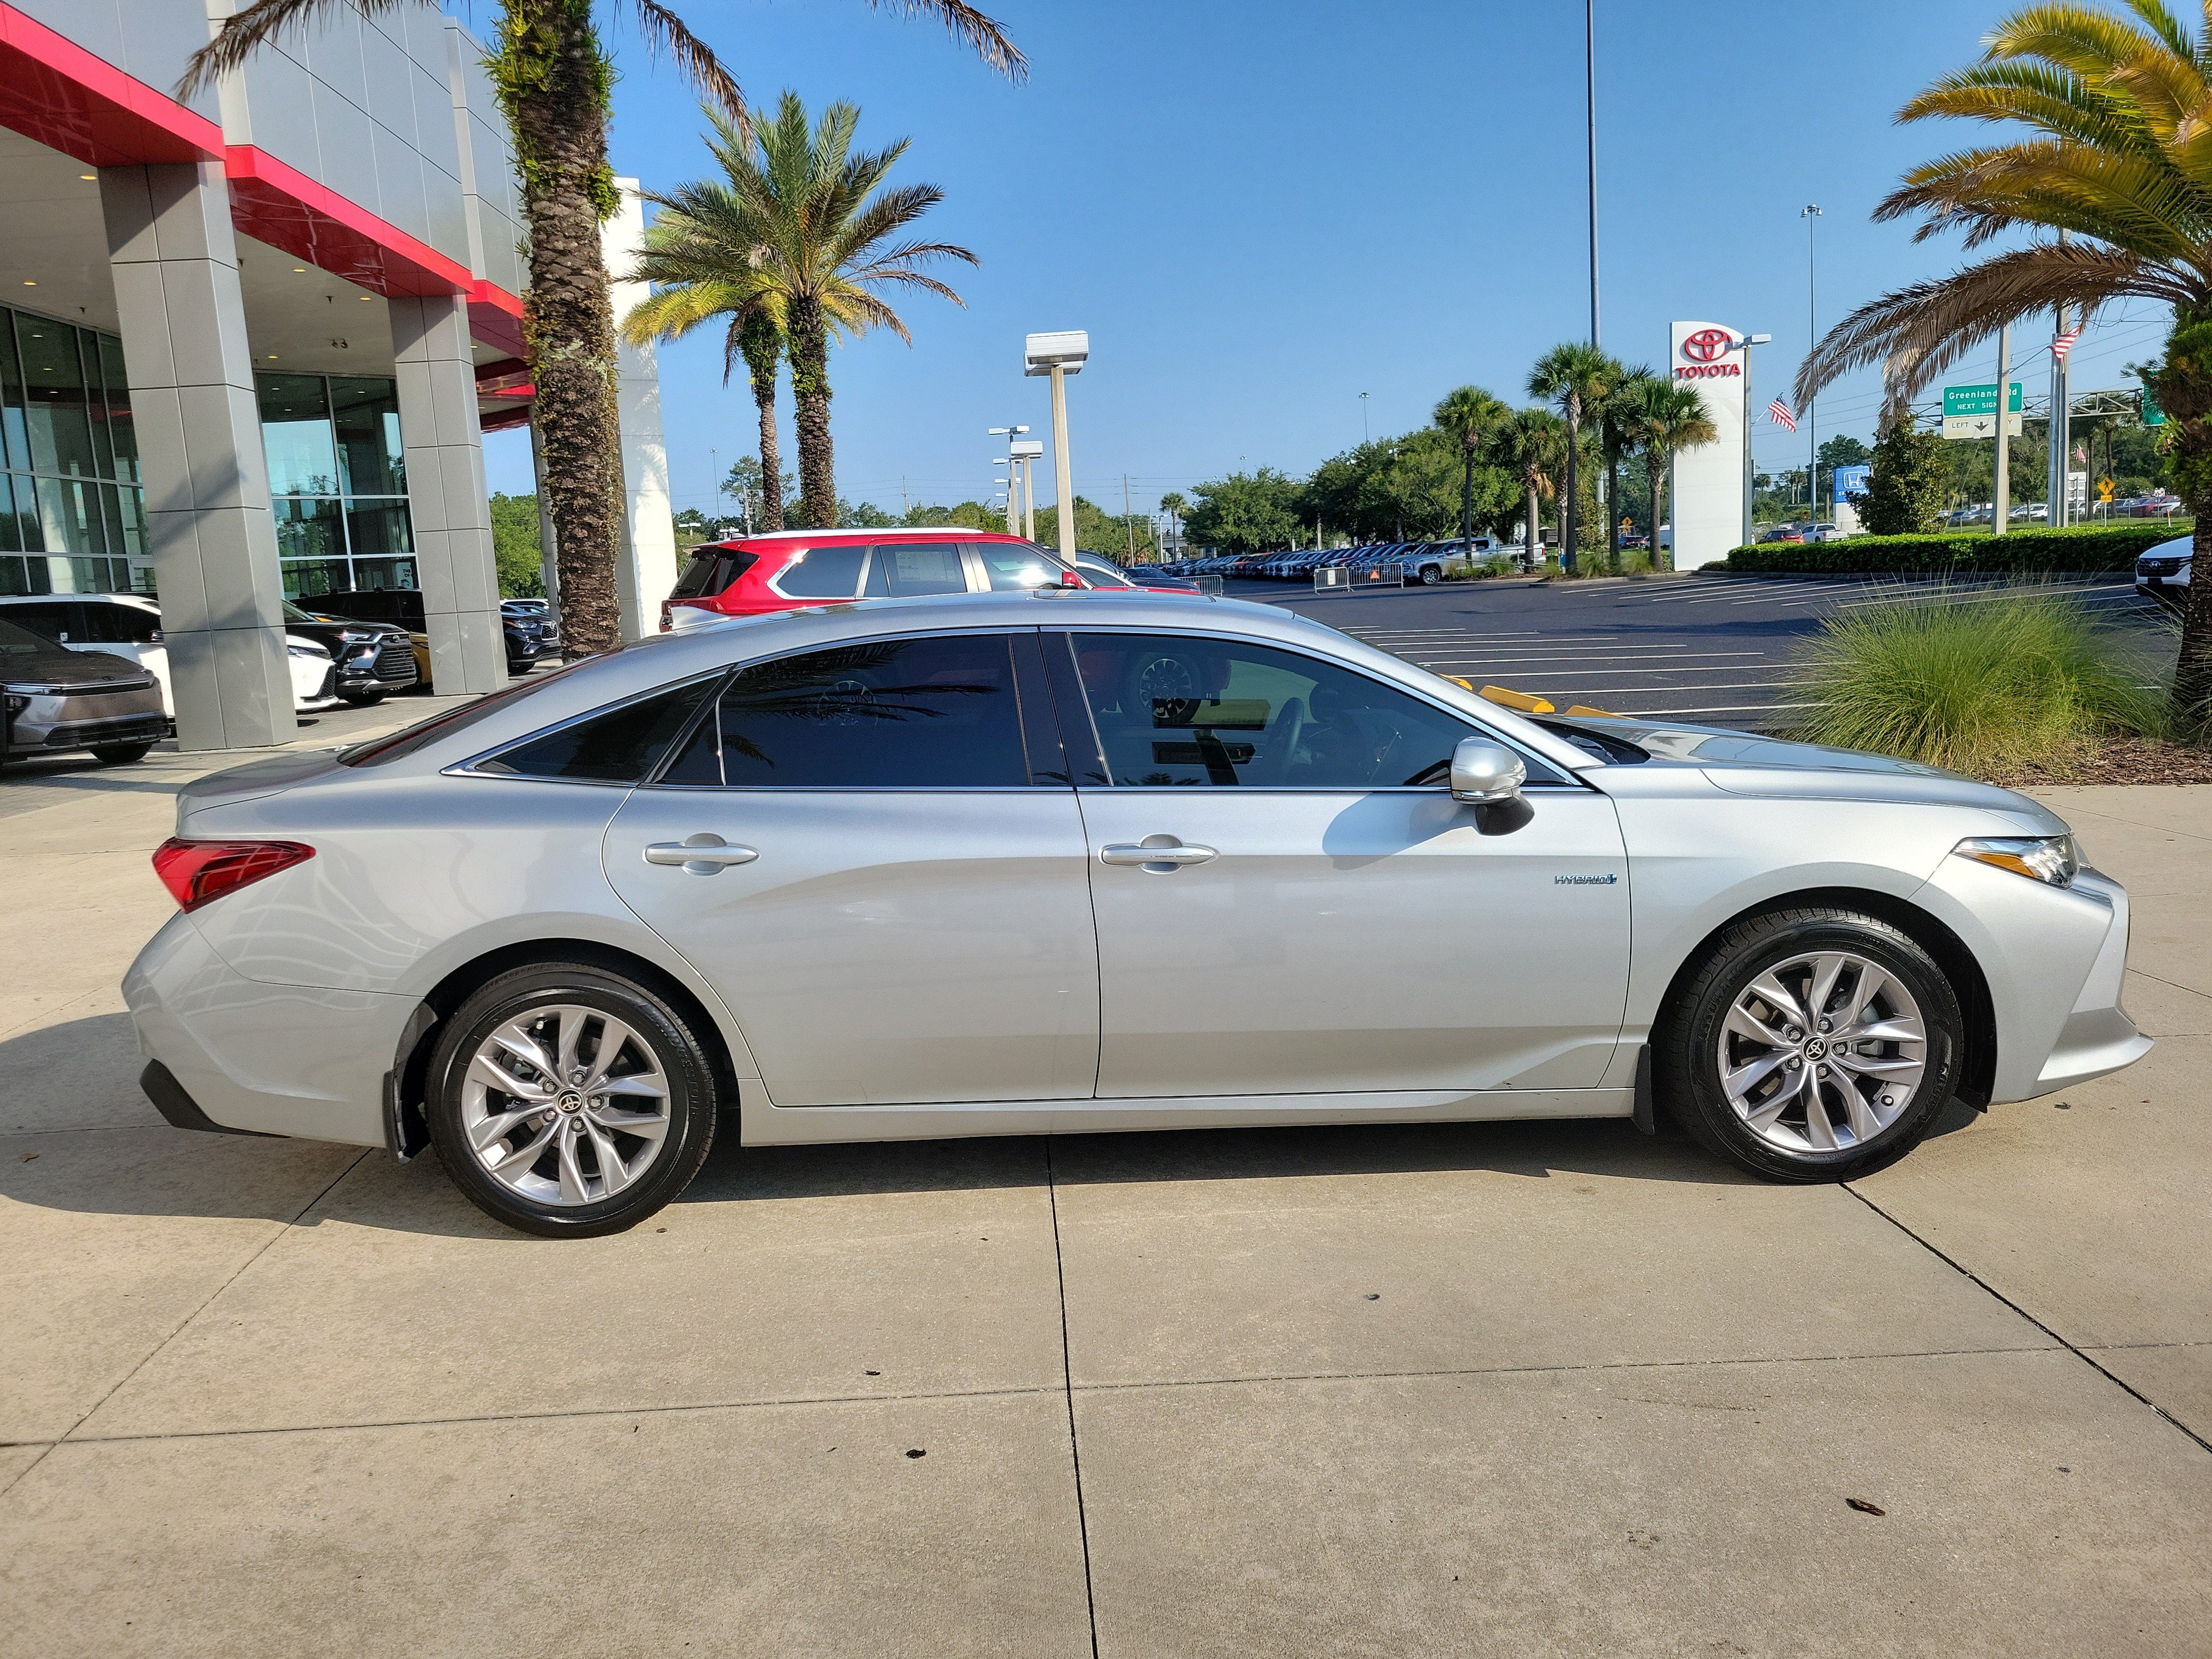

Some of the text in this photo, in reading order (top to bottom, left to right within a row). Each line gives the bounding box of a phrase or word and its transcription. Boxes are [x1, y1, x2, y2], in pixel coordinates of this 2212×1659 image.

[1676, 363, 1741, 379] TOYOTA
[1949, 390, 1997, 400] Greenland
[1554, 874, 1609, 884] HYBRID
